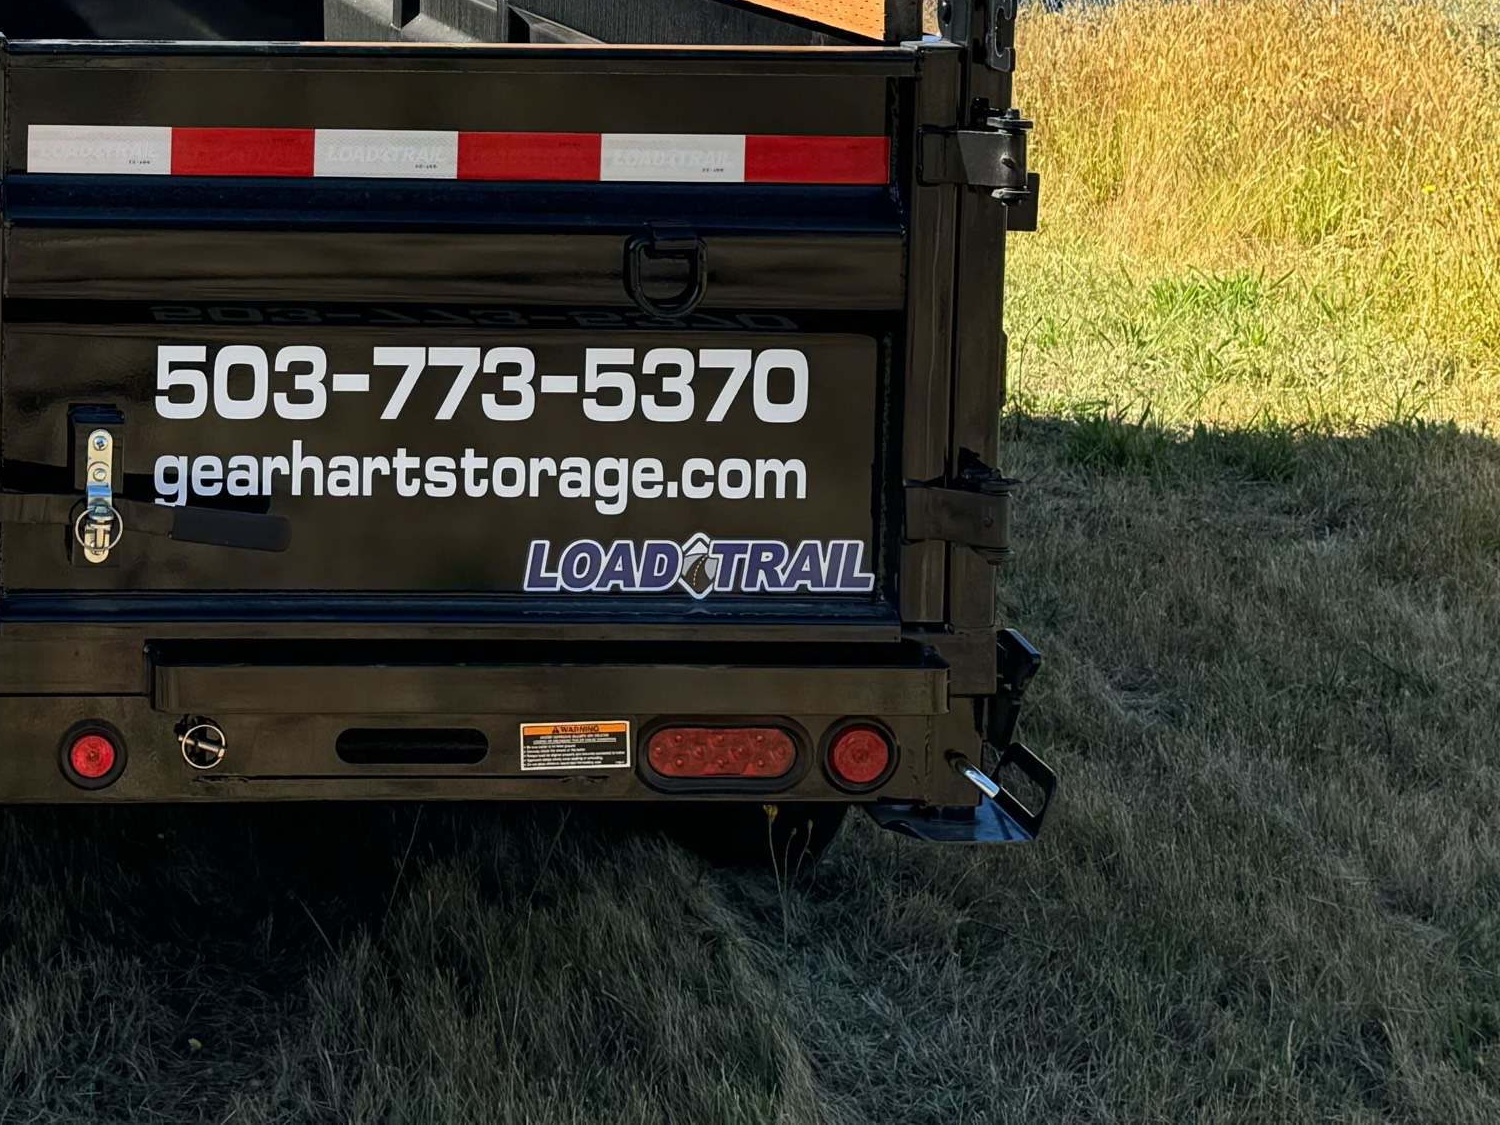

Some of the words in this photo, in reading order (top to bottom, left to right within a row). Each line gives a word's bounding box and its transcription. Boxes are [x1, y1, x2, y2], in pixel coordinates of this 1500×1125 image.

[155, 345, 809, 423] 503-773-5370
[153, 441, 808, 515] gearhartstorage.com
[523, 539, 682, 592] LOAD
[709, 539, 875, 592] TRAIL
[560, 724, 600, 734] WARNING
